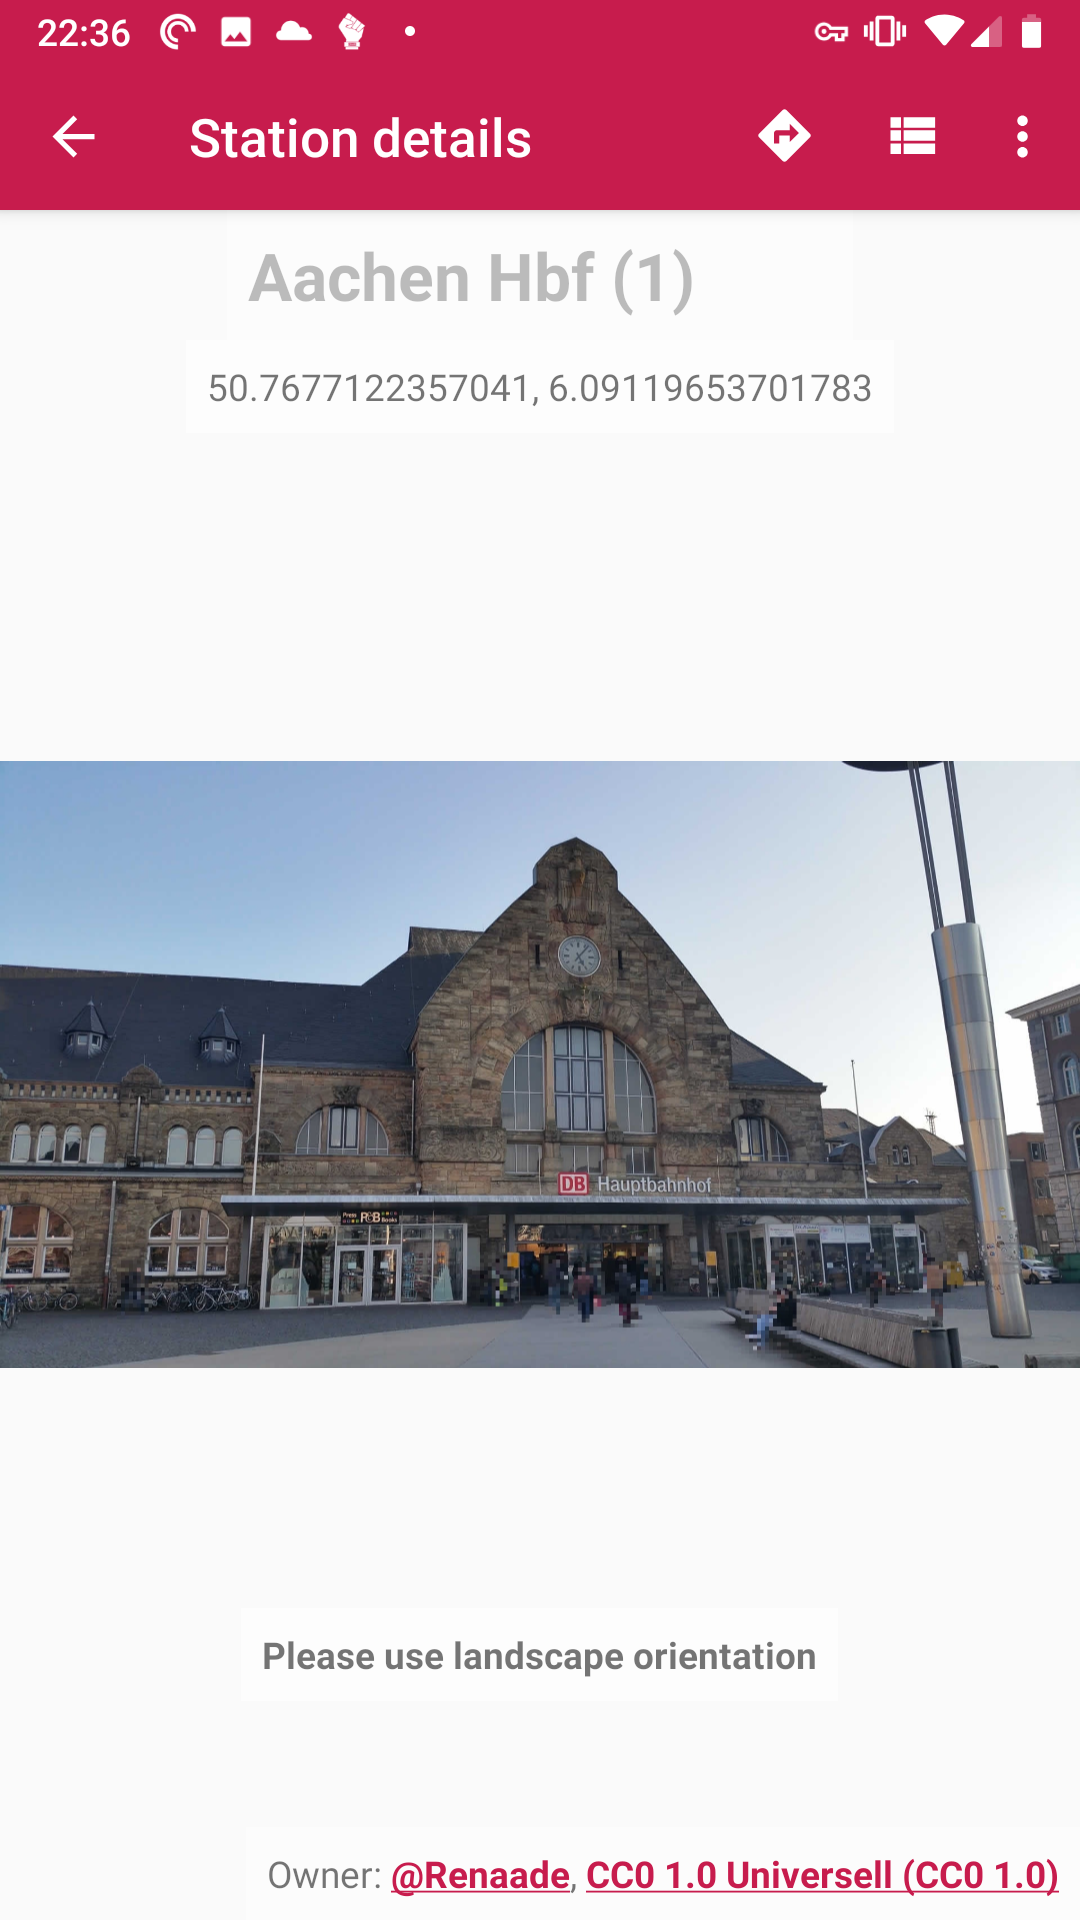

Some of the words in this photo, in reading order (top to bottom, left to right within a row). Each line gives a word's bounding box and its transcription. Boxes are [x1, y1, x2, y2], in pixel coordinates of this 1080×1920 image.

[38, 19, 130, 47] 22:36
[190, 117, 358, 158] Station
[373, 117, 532, 158] details
[248, 250, 469, 303] Aachen
[490, 250, 596, 303] Hbf
[614, 248, 693, 317] (1)
[209, 374, 538, 406] 50.7677122357041,
[549, 374, 872, 403] 6.09119653701783
[562, 1176, 586, 1191] DB
[598, 1176, 712, 1195] Hauptbahnhof
[264, 1641, 375, 1671] Please
[385, 1648, 444, 1671] use
[455, 1641, 624, 1678] landscape
[634, 1641, 816, 1671] orientation
[268, 1860, 381, 1890] Owner:
[391, 1860, 577, 1897] @Renaade,
[586, 1860, 655, 1892] CC0
[666, 1860, 717, 1892] 1.0
[727, 1859, 892, 1892] Universell
[903, 1858, 984, 1897] (CC0
[995, 1858, 1059, 1897] 1.0)
